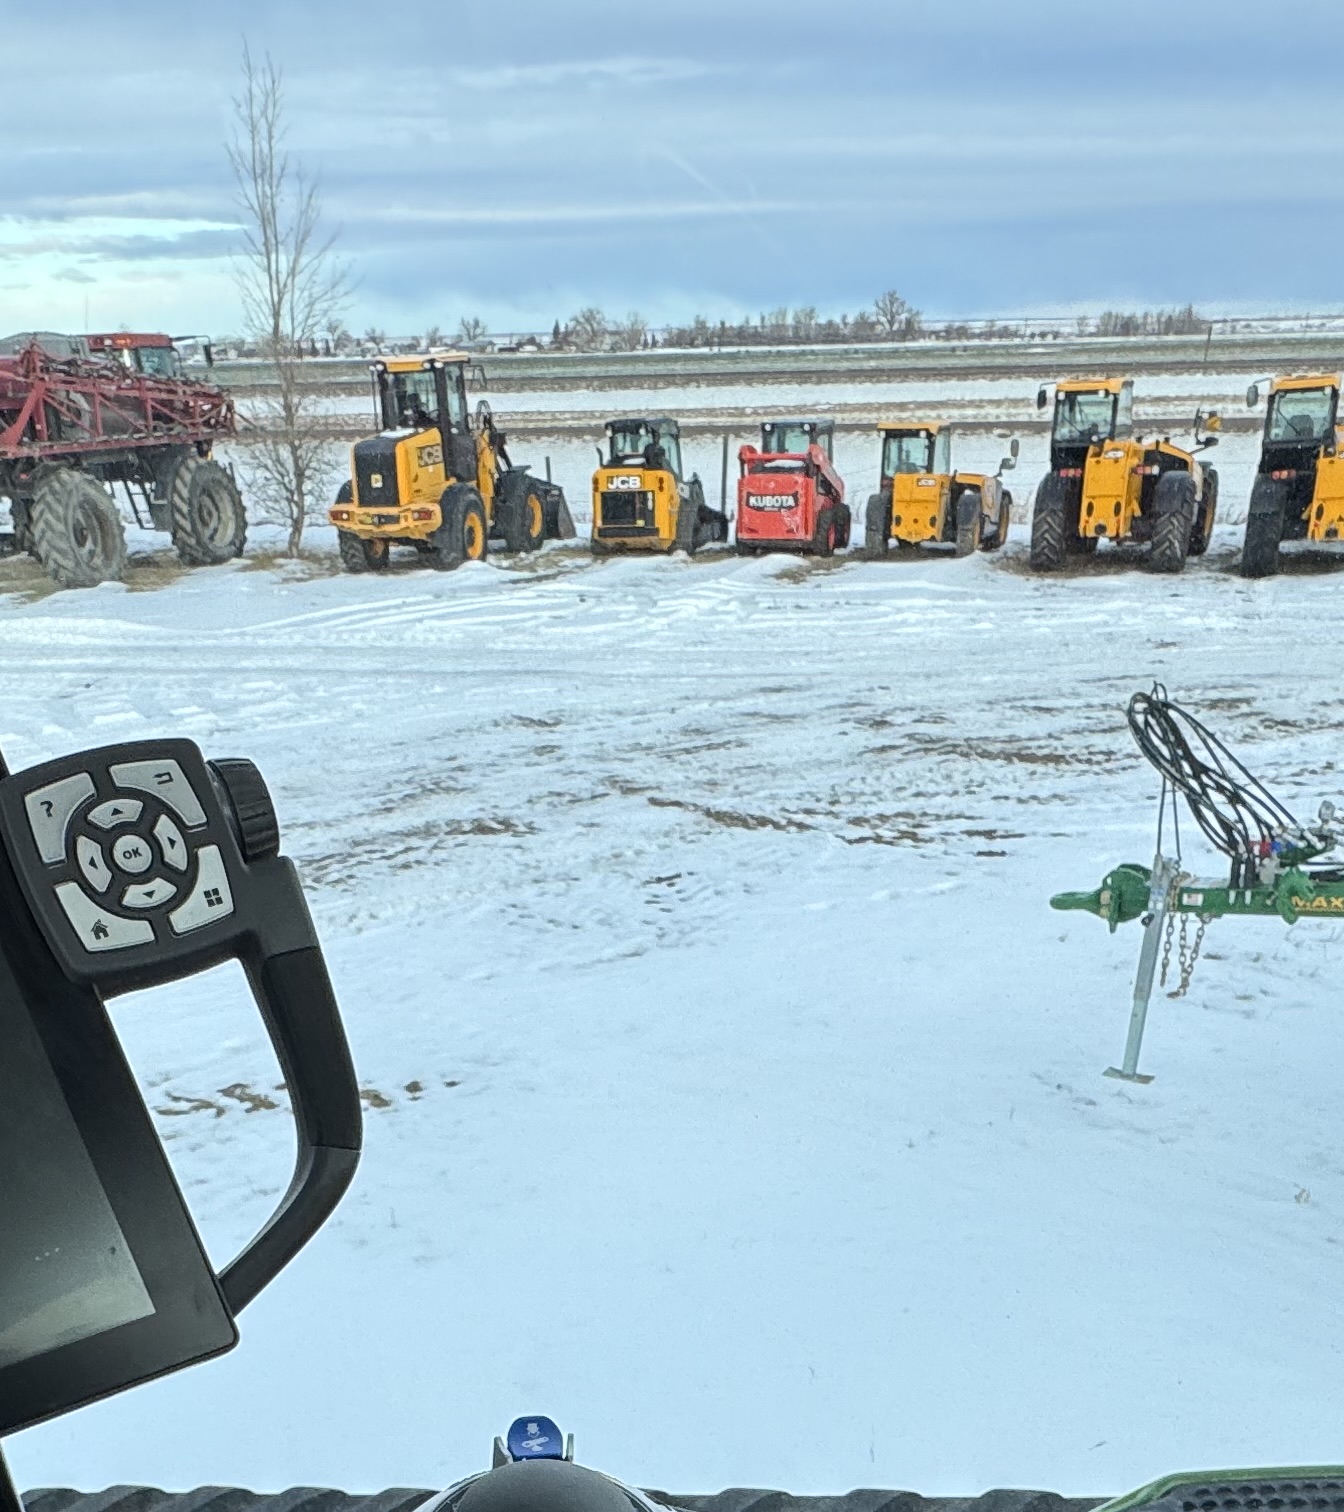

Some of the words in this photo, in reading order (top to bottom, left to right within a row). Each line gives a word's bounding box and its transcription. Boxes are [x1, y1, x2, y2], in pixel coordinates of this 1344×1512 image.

[607, 475, 641, 489] JCB
[748, 495, 796, 508] KUBOTA
[122, 847, 143, 860] OK
